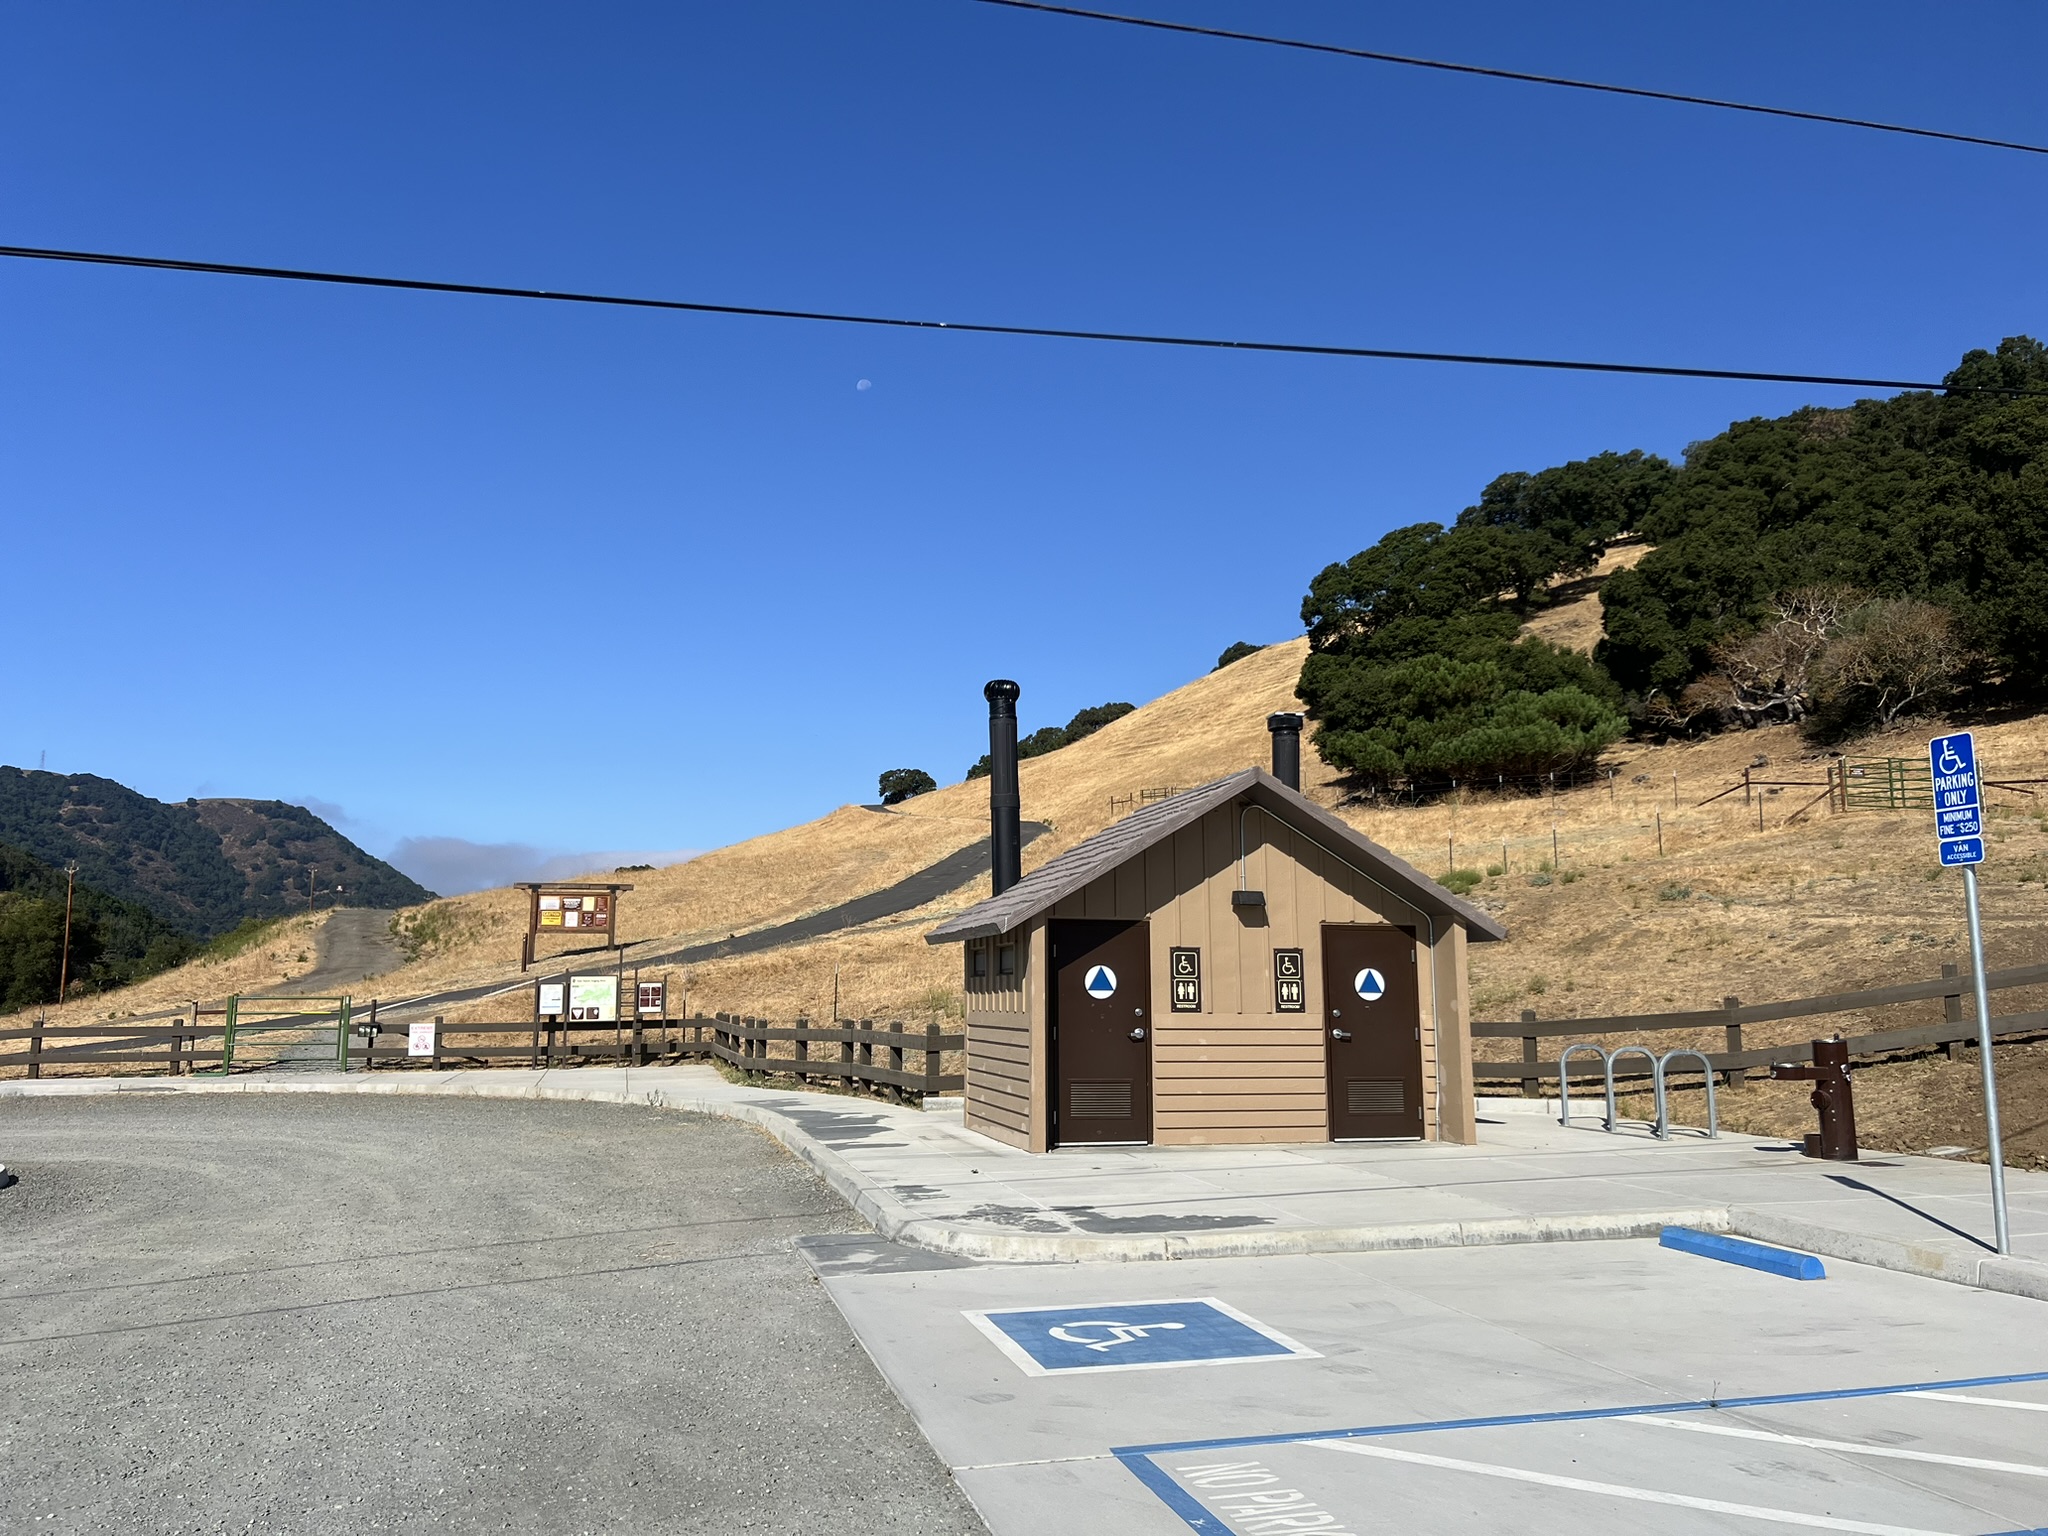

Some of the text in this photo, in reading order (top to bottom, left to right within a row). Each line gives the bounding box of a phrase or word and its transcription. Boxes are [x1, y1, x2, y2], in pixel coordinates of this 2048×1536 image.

[1935, 772, 1974, 791] PARKING
[1944, 789, 1967, 806] ONLY
[1943, 810, 1972, 823] MINIMUM
[1940, 821, 1978, 835] FINE $250
[1953, 844, 1969, 852] VAN
[1947, 851, 1977, 860] ACCESSIBLE
[1176, 1461, 1280, 1489] NO
